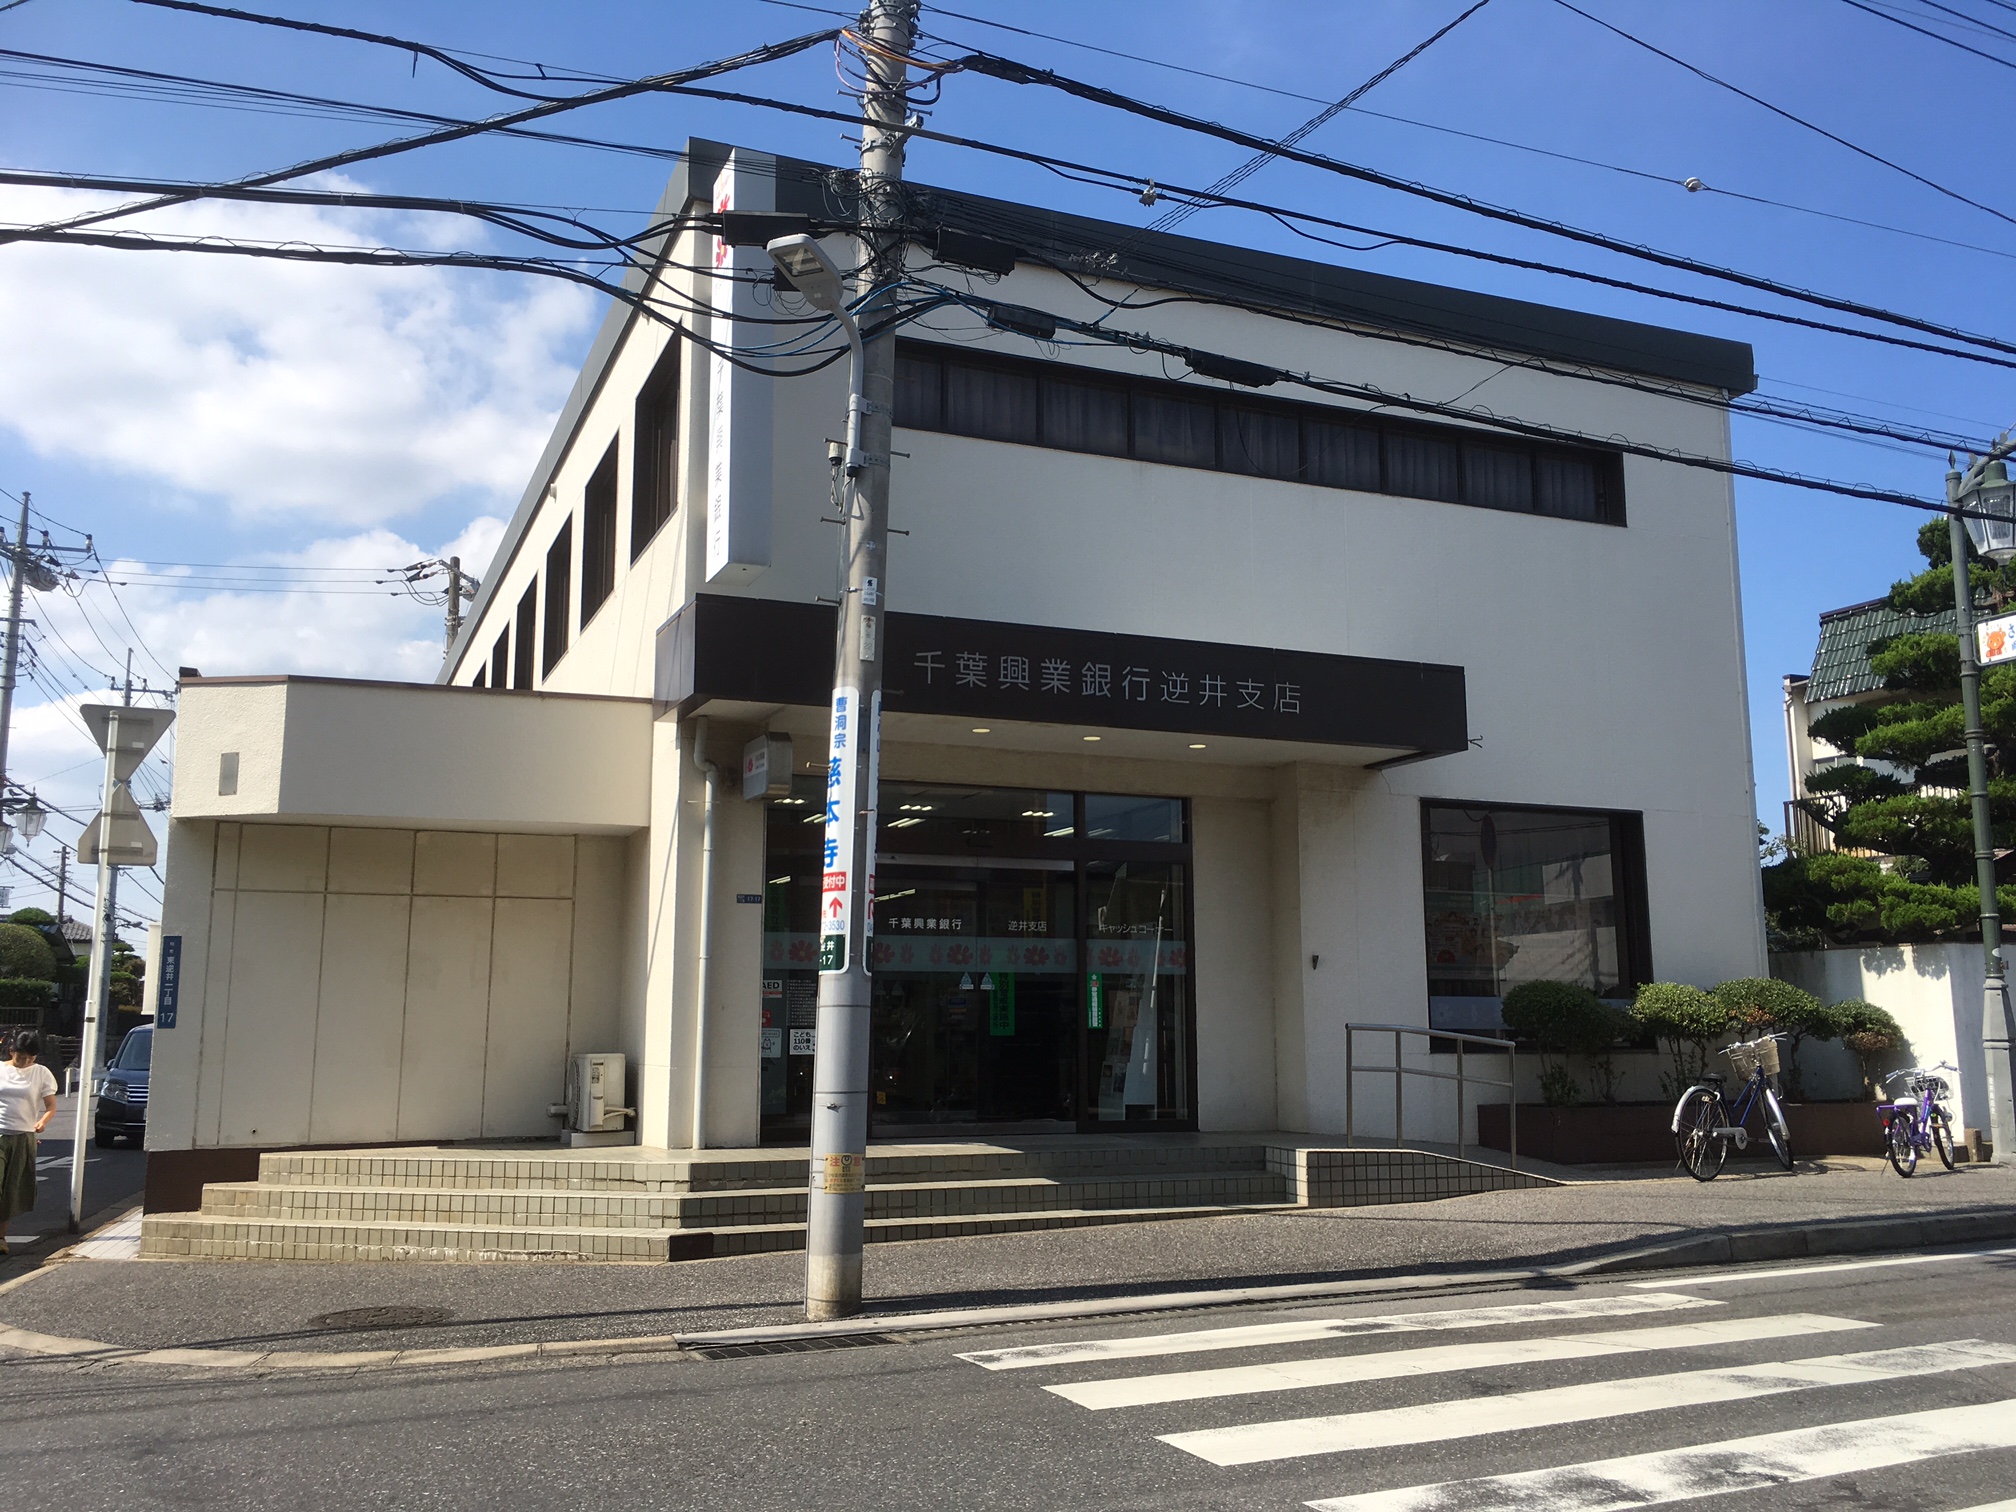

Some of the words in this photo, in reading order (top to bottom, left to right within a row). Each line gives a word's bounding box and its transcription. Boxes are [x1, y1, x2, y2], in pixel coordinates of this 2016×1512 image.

[913, 650, 1301, 714] 千葉興業銀行逆井支店
[834, 696, 848, 749] 曹洞宗
[888, 917, 963, 930] 千葉興業銀行
[1008, 920, 1047, 932] 逆井支店
[164, 956, 175, 1006] 東逆井一丁目
[160, 1012, 174, 1023] 17
